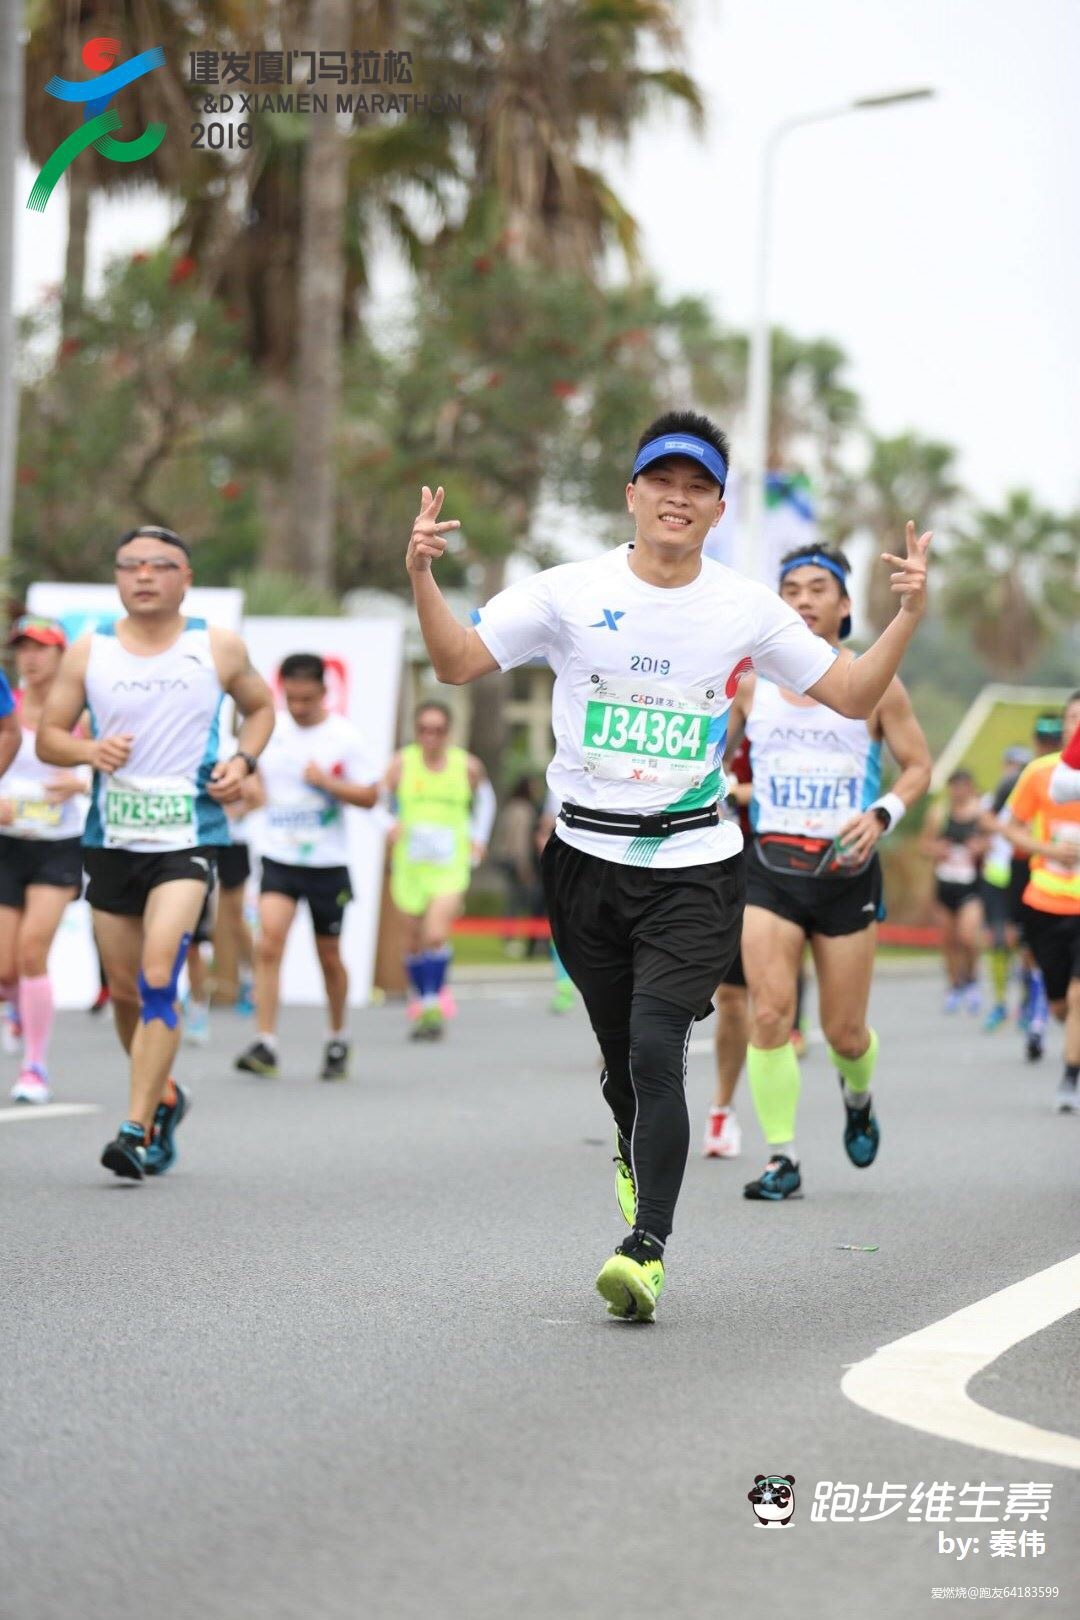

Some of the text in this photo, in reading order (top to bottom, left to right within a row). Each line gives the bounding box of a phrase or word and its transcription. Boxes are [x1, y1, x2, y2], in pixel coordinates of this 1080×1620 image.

[630, 655, 671, 676] 2019
[112, 678, 189, 692] ANTA
[592, 705, 702, 759] J34364
[769, 727, 839, 742] ANTA
